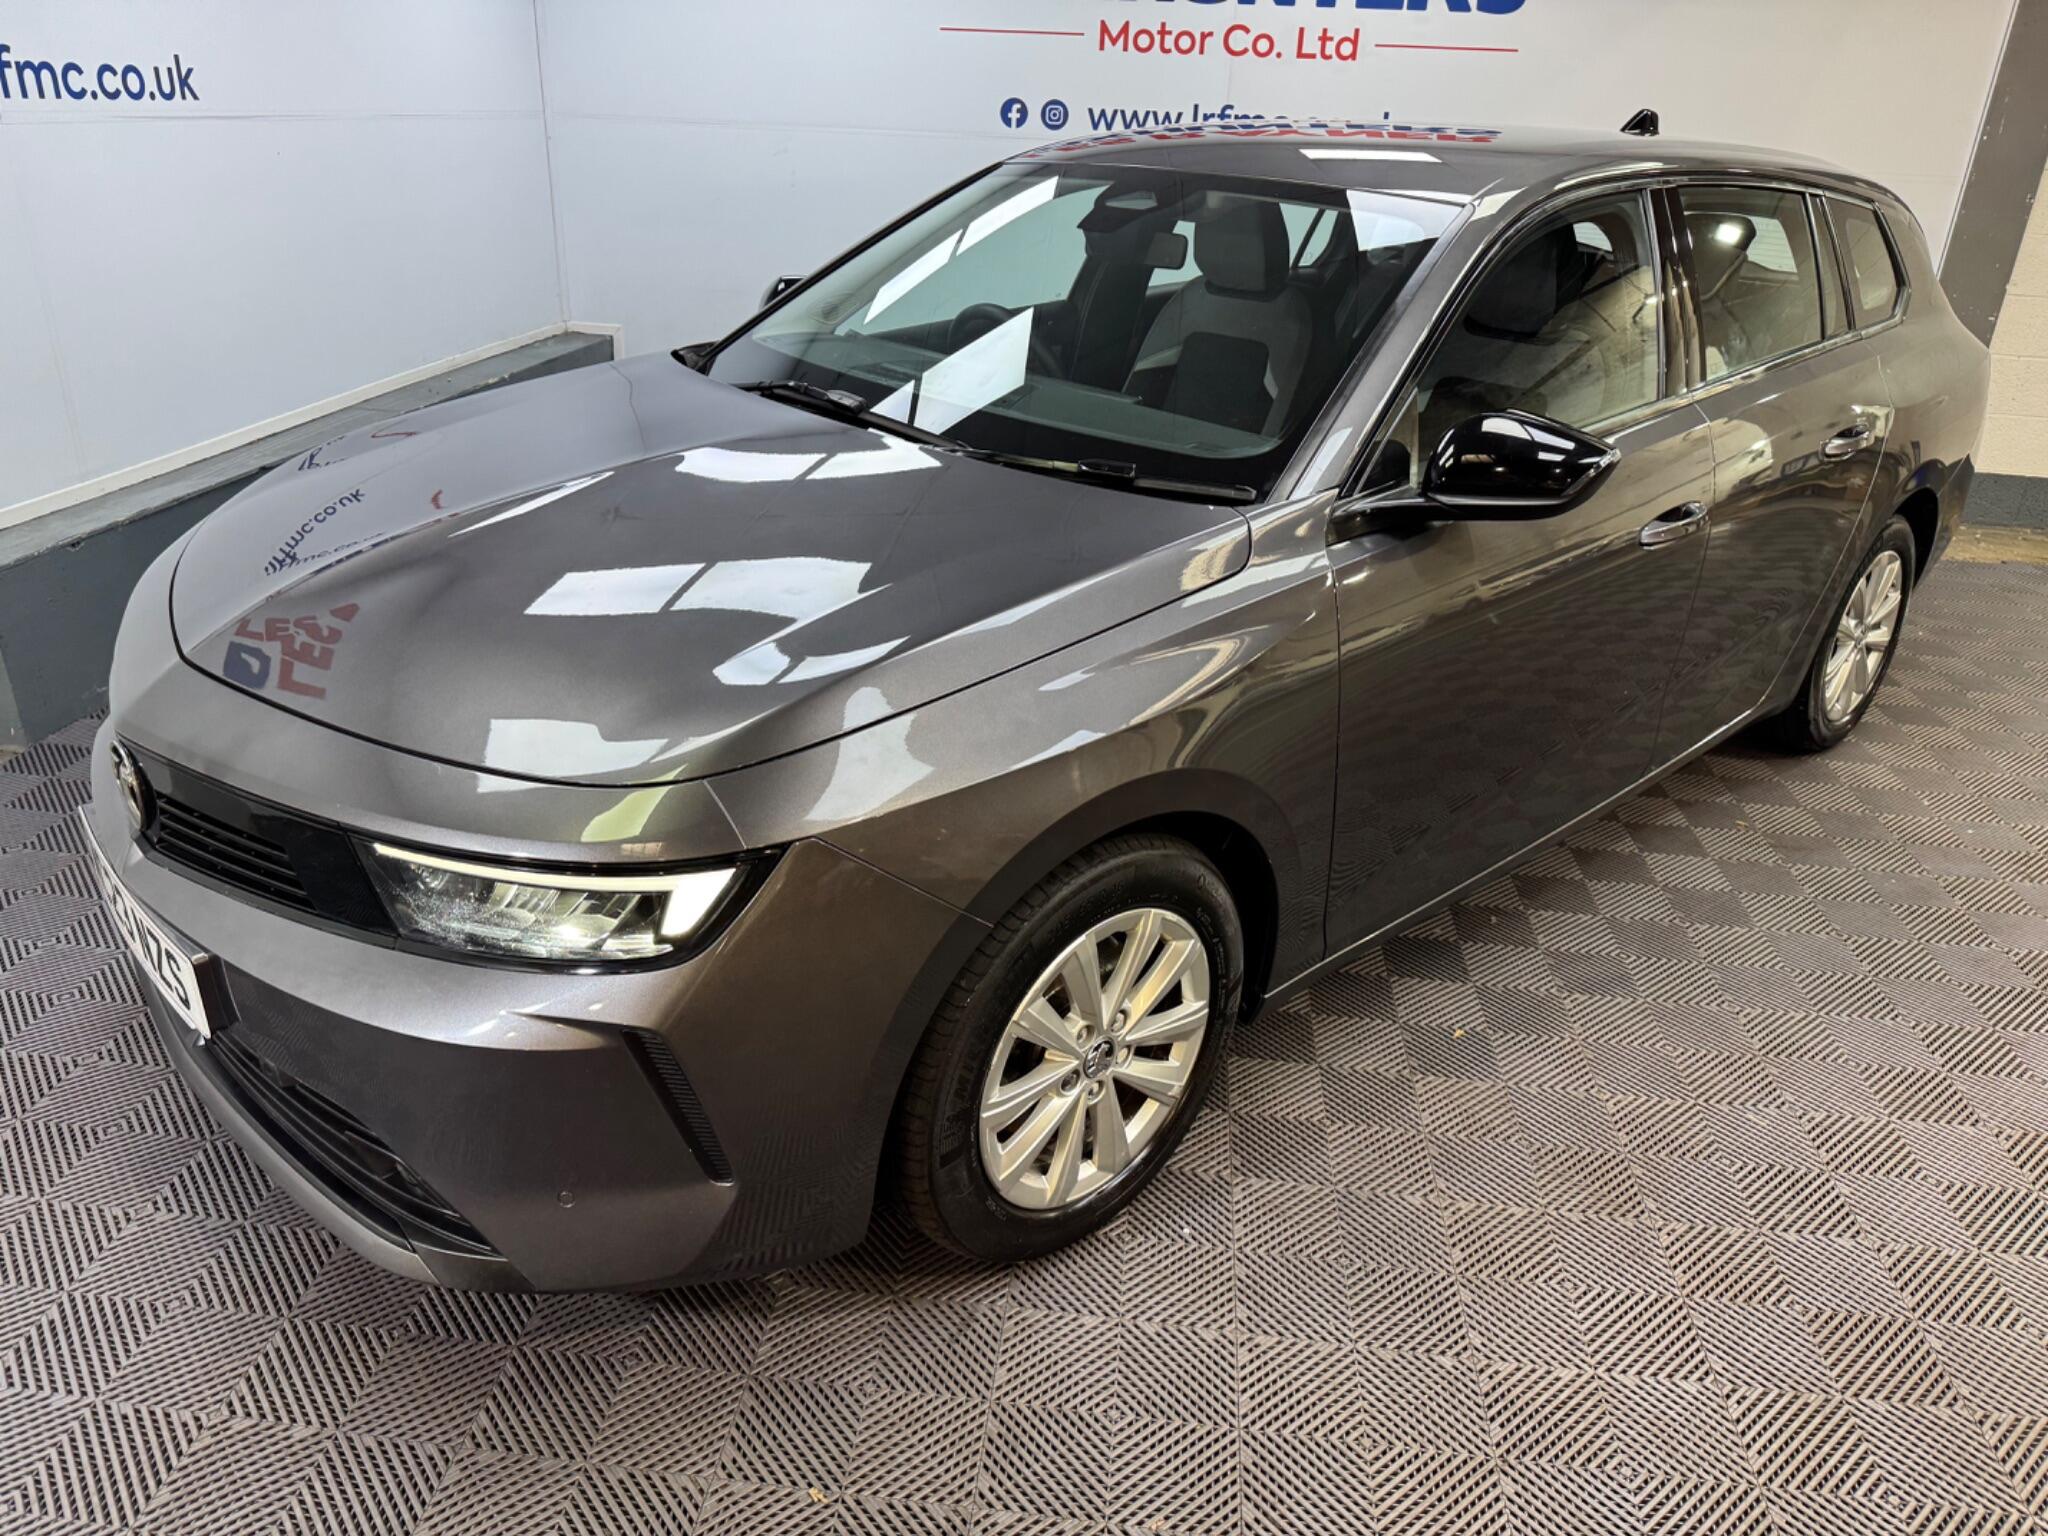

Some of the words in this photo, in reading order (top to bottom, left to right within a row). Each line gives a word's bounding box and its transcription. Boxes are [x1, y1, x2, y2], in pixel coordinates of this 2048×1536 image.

[1099, 19, 1214, 55] Motor
[1222, 23, 1282, 58] Co.
[1295, 26, 1361, 61] Ltd
